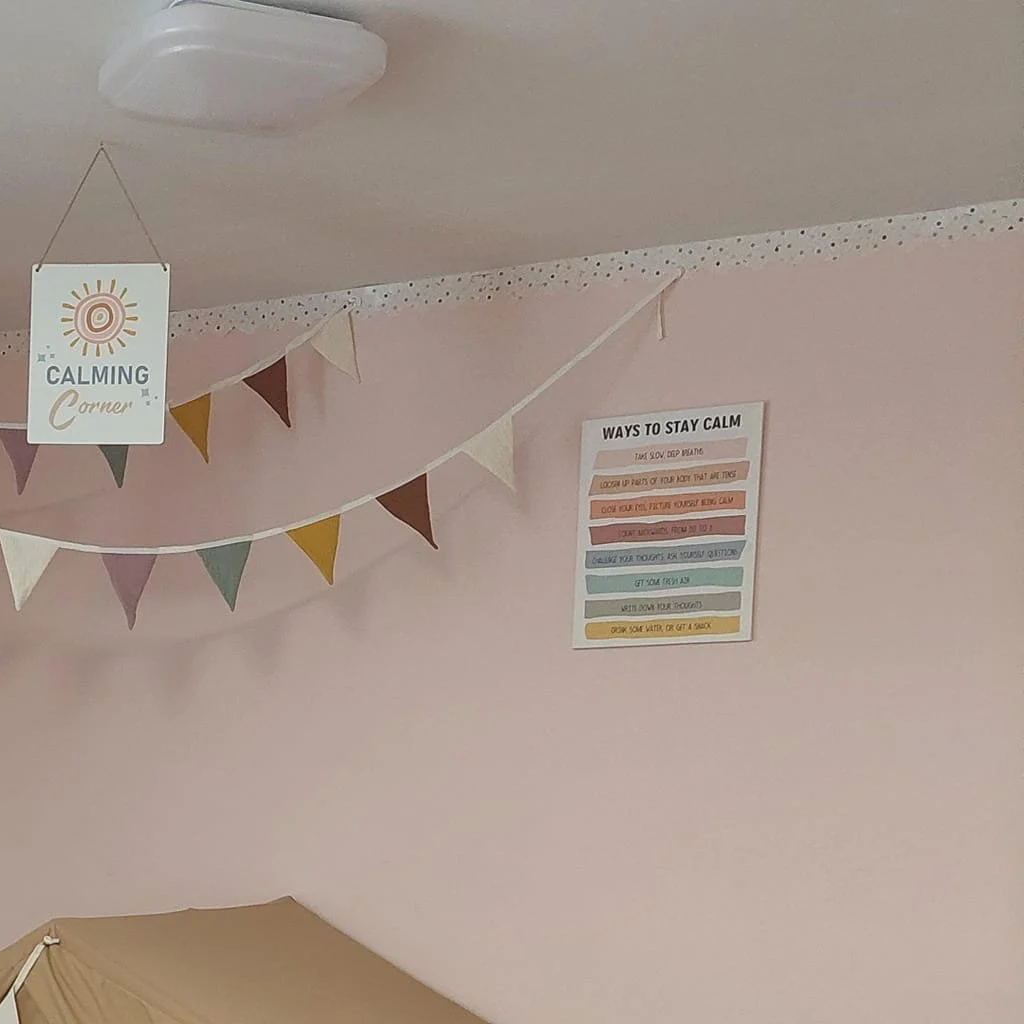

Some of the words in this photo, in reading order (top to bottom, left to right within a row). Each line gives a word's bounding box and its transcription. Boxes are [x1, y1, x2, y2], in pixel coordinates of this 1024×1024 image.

[46, 366, 149, 385] CALMING
[49, 389, 132, 430] Corner
[603, 424, 641, 440] WAYS
[645, 423, 660, 436] TO
[665, 418, 699, 434] STAY
[703, 414, 741, 430] CALM
[634, 452, 648, 461] TAKE
[667, 450, 680, 458] DEEP
[622, 479, 630, 488] UP
[631, 478, 648, 487] PARTS
[650, 477, 658, 485] OF
[660, 476, 674, 485] YOUR
[693, 472, 707, 482] THAT
[709, 471, 719, 480] ARE
[619, 555, 633, 563] YOUR
[634, 579, 644, 588] GET
[646, 578, 660, 587] SOME
[638, 603, 655, 612] DOWN
[657, 602, 673, 611] YOUR
[630, 625, 644, 633] SOME
[665, 623, 674, 631] OR
[676, 622, 686, 631] GET
